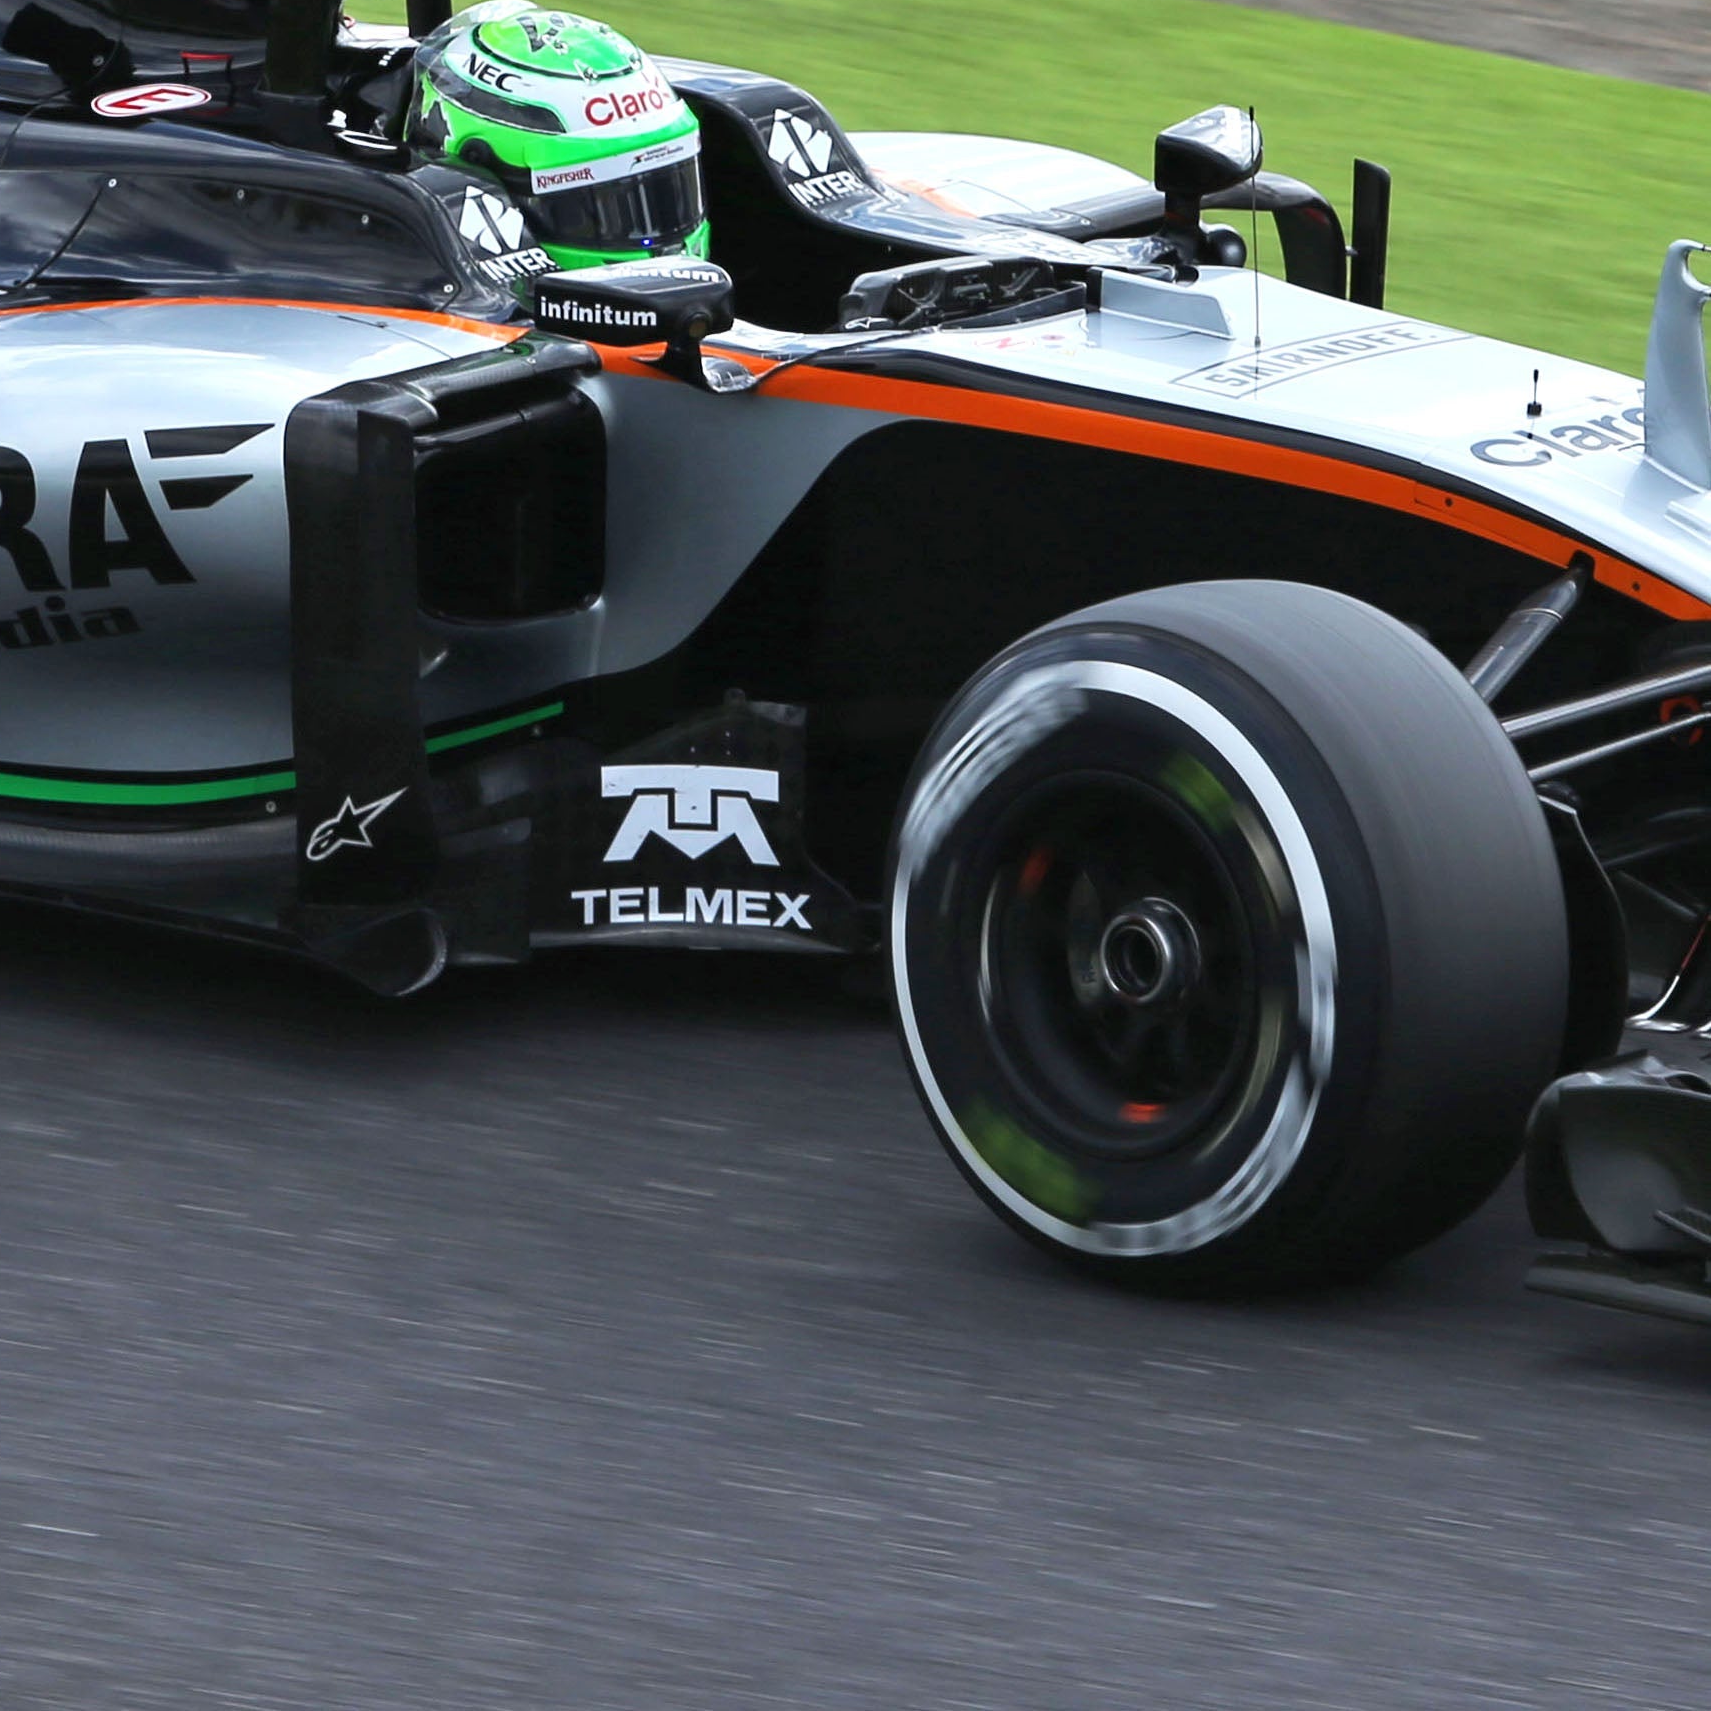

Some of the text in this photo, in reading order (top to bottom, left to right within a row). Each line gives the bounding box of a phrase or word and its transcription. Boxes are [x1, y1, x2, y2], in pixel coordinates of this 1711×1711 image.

[462, 53, 522, 92] NEC
[105, 88, 195, 110] E
[585, 89, 663, 126] Claro
[536, 168, 595, 189] KINGFISHER
[788, 171, 865, 207] INTER
[479, 247, 556, 281] INTER
[540, 296, 657, 326] infinitum
[571, 887, 811, 930] TELMEX
